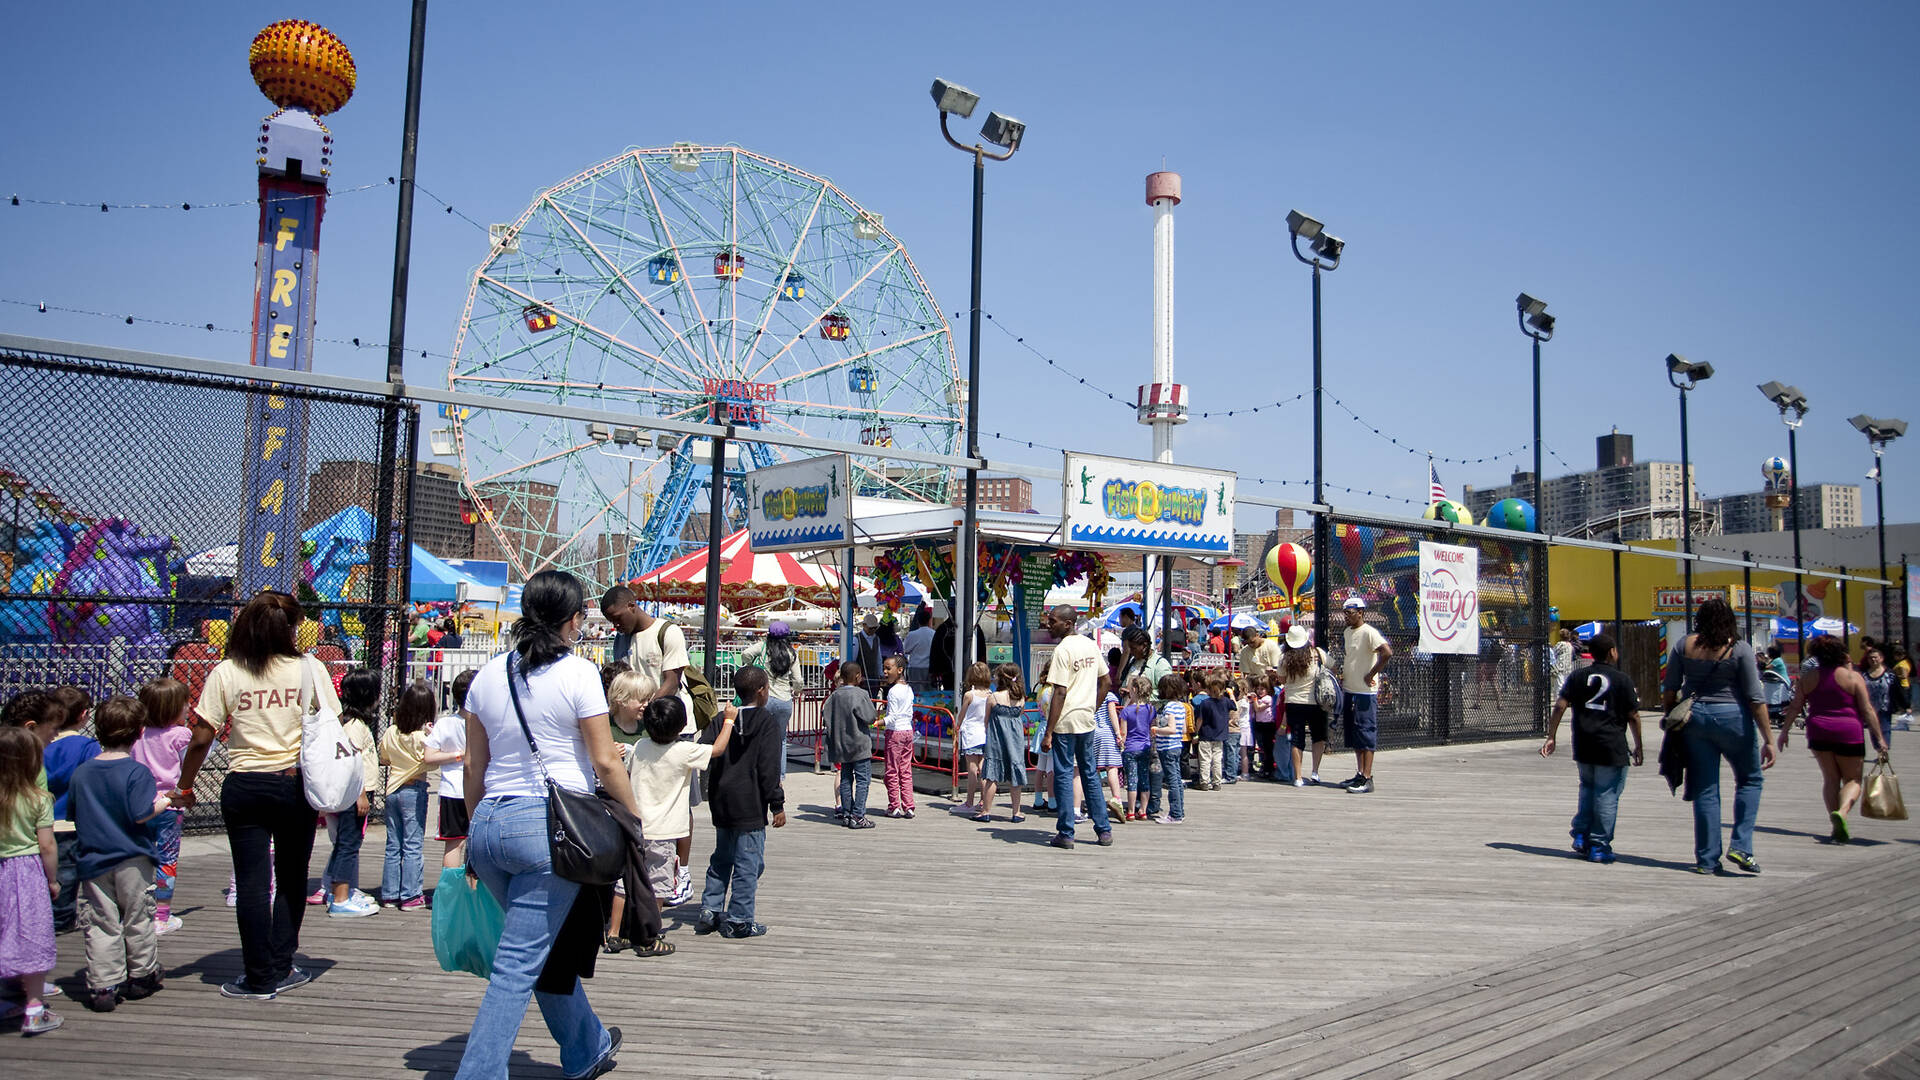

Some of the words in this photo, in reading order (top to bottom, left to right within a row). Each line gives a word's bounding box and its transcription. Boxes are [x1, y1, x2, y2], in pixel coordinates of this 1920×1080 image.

[703, 378, 777, 402] WONDER
[259, 217, 299, 590] FREEFAL
[1434, 549, 1465, 564] WELCOME
[1426, 589, 1450, 601] WONDER
[1661, 591, 1723, 605] TICETS
[1430, 601, 1448, 612] WHEEL
[1437, 588, 1476, 632] 90
[1584, 673, 1610, 711] 2
